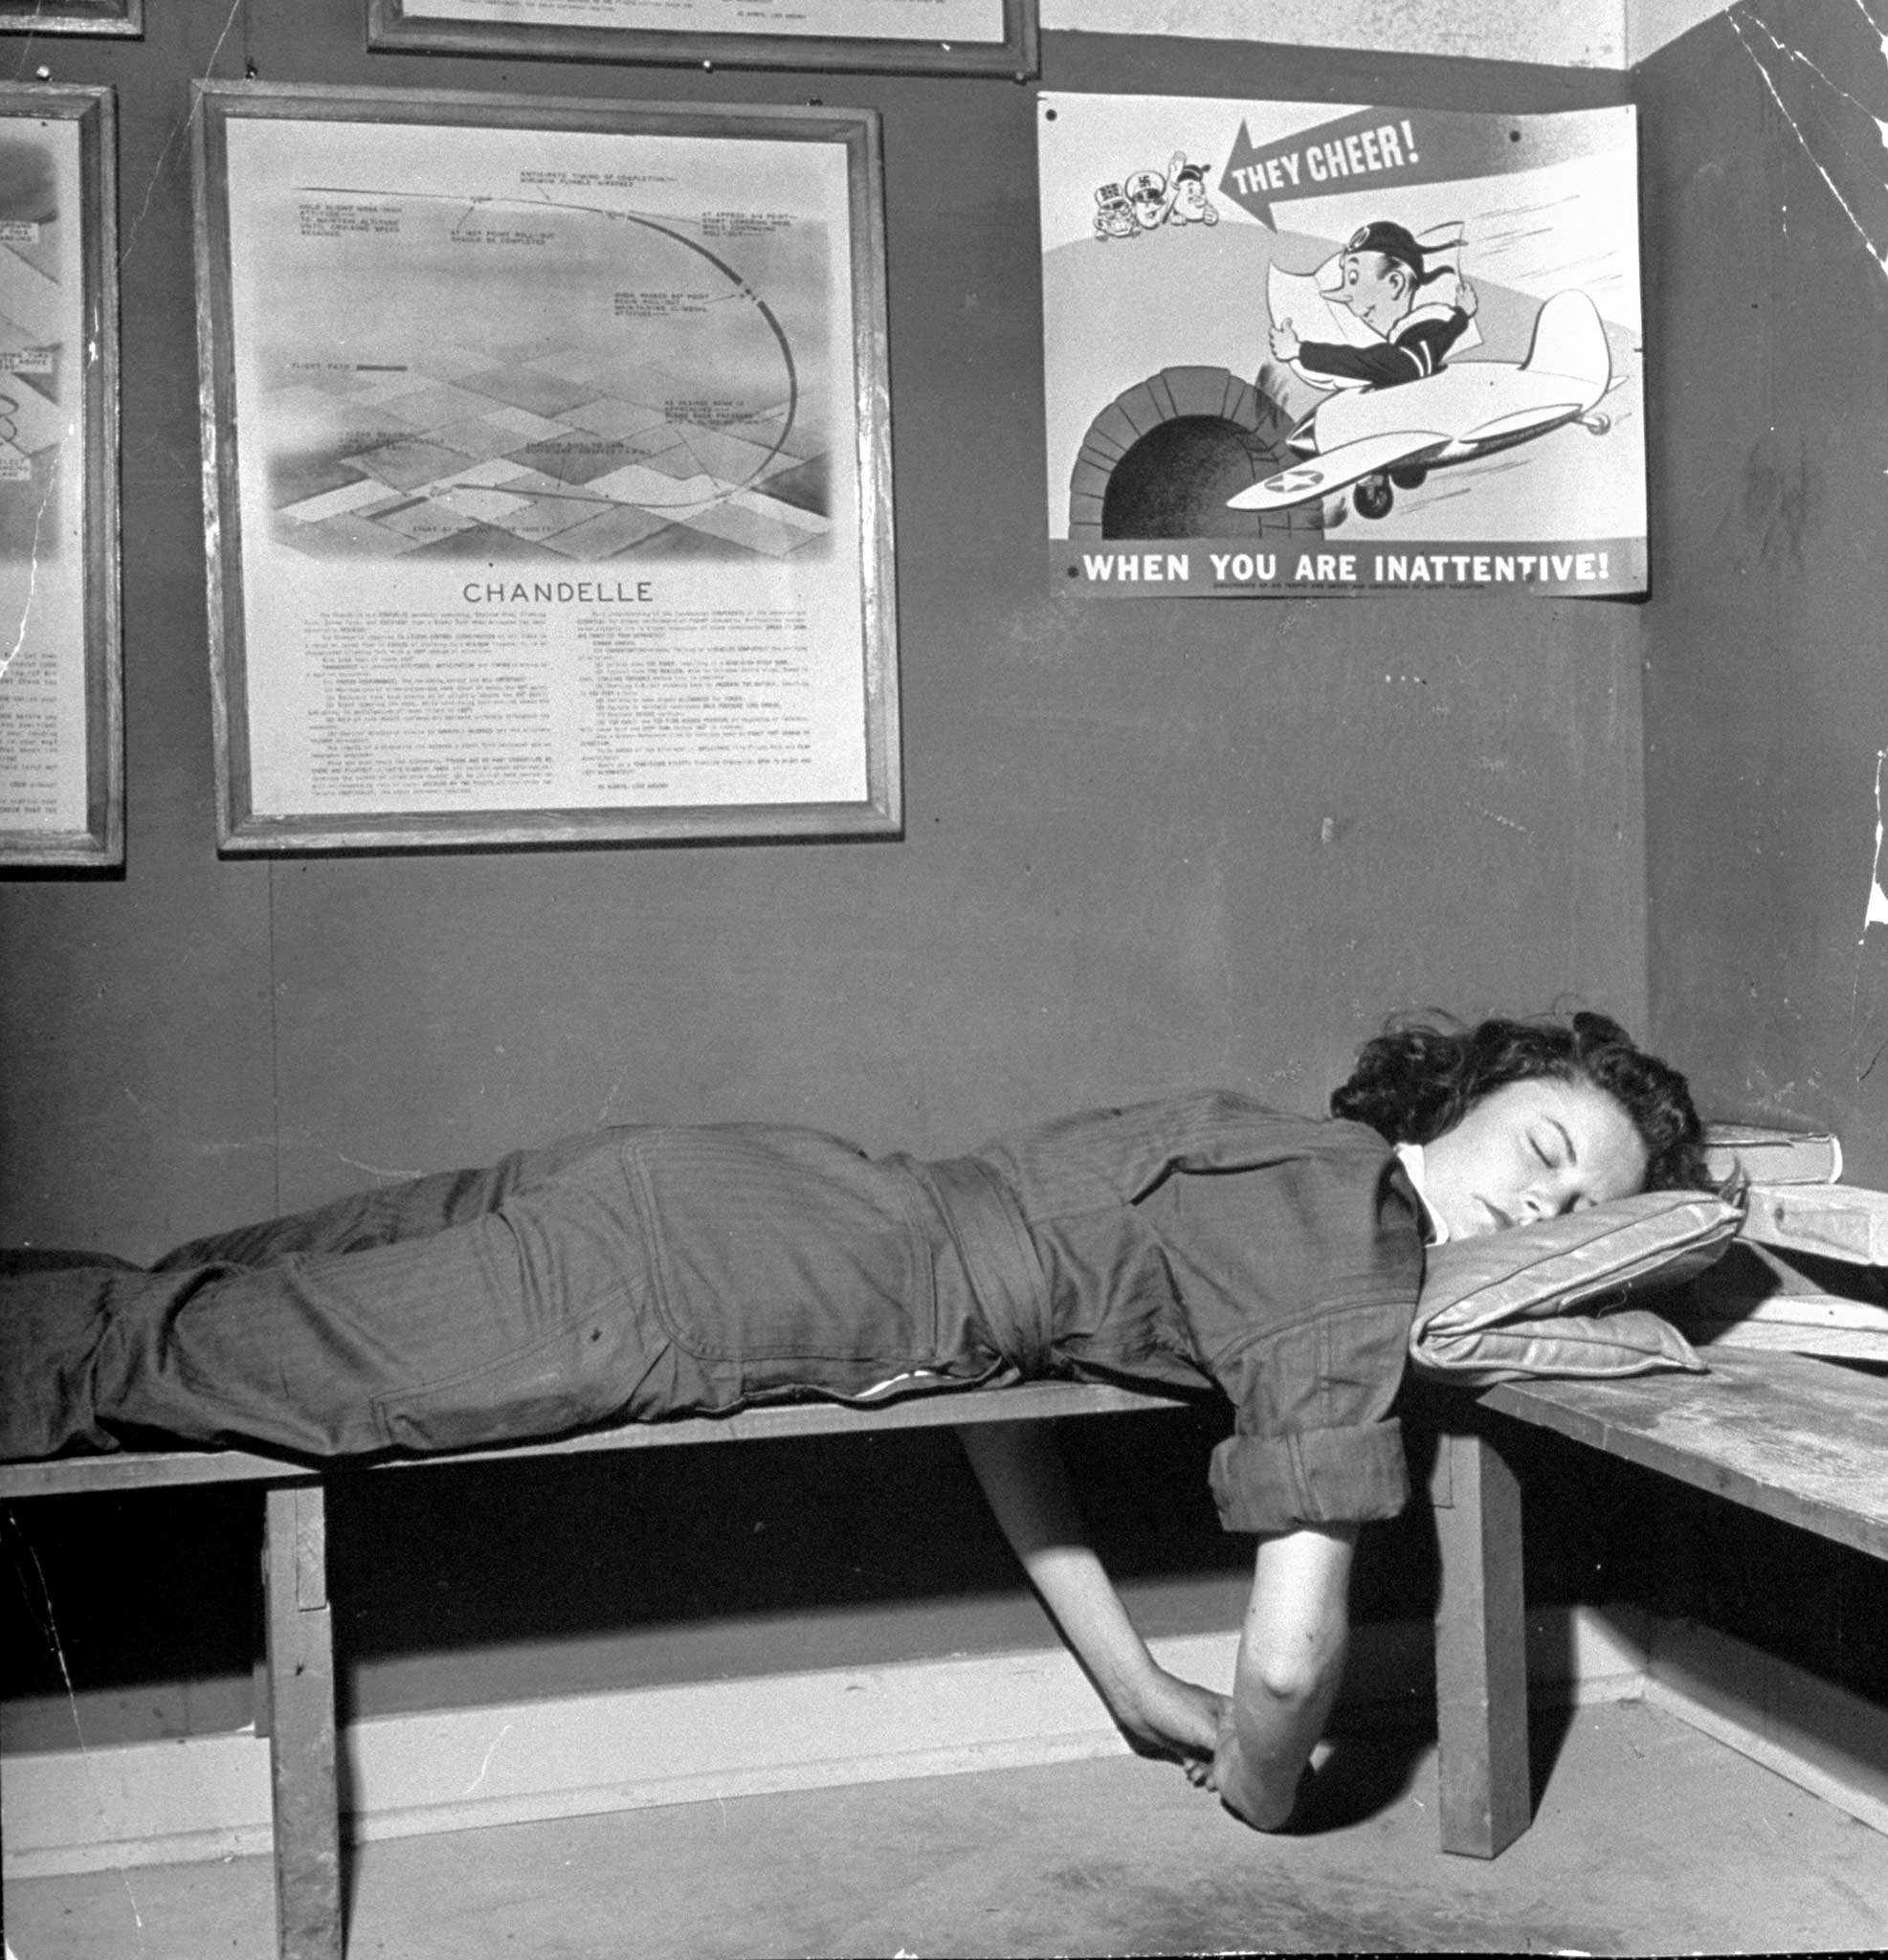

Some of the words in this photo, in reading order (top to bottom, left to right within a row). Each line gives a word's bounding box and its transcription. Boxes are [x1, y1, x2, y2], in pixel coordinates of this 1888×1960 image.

[1232, 153, 1300, 194] THEY
[1306, 120, 1419, 182] CHEER!
[1083, 554, 1188, 581] WHEN
[1210, 554, 1276, 580] YOU
[1295, 554, 1356, 581] ARE
[1375, 553, 1609, 581] INATTENTIVE!
[463, 582, 654, 602] CHANDELLE
